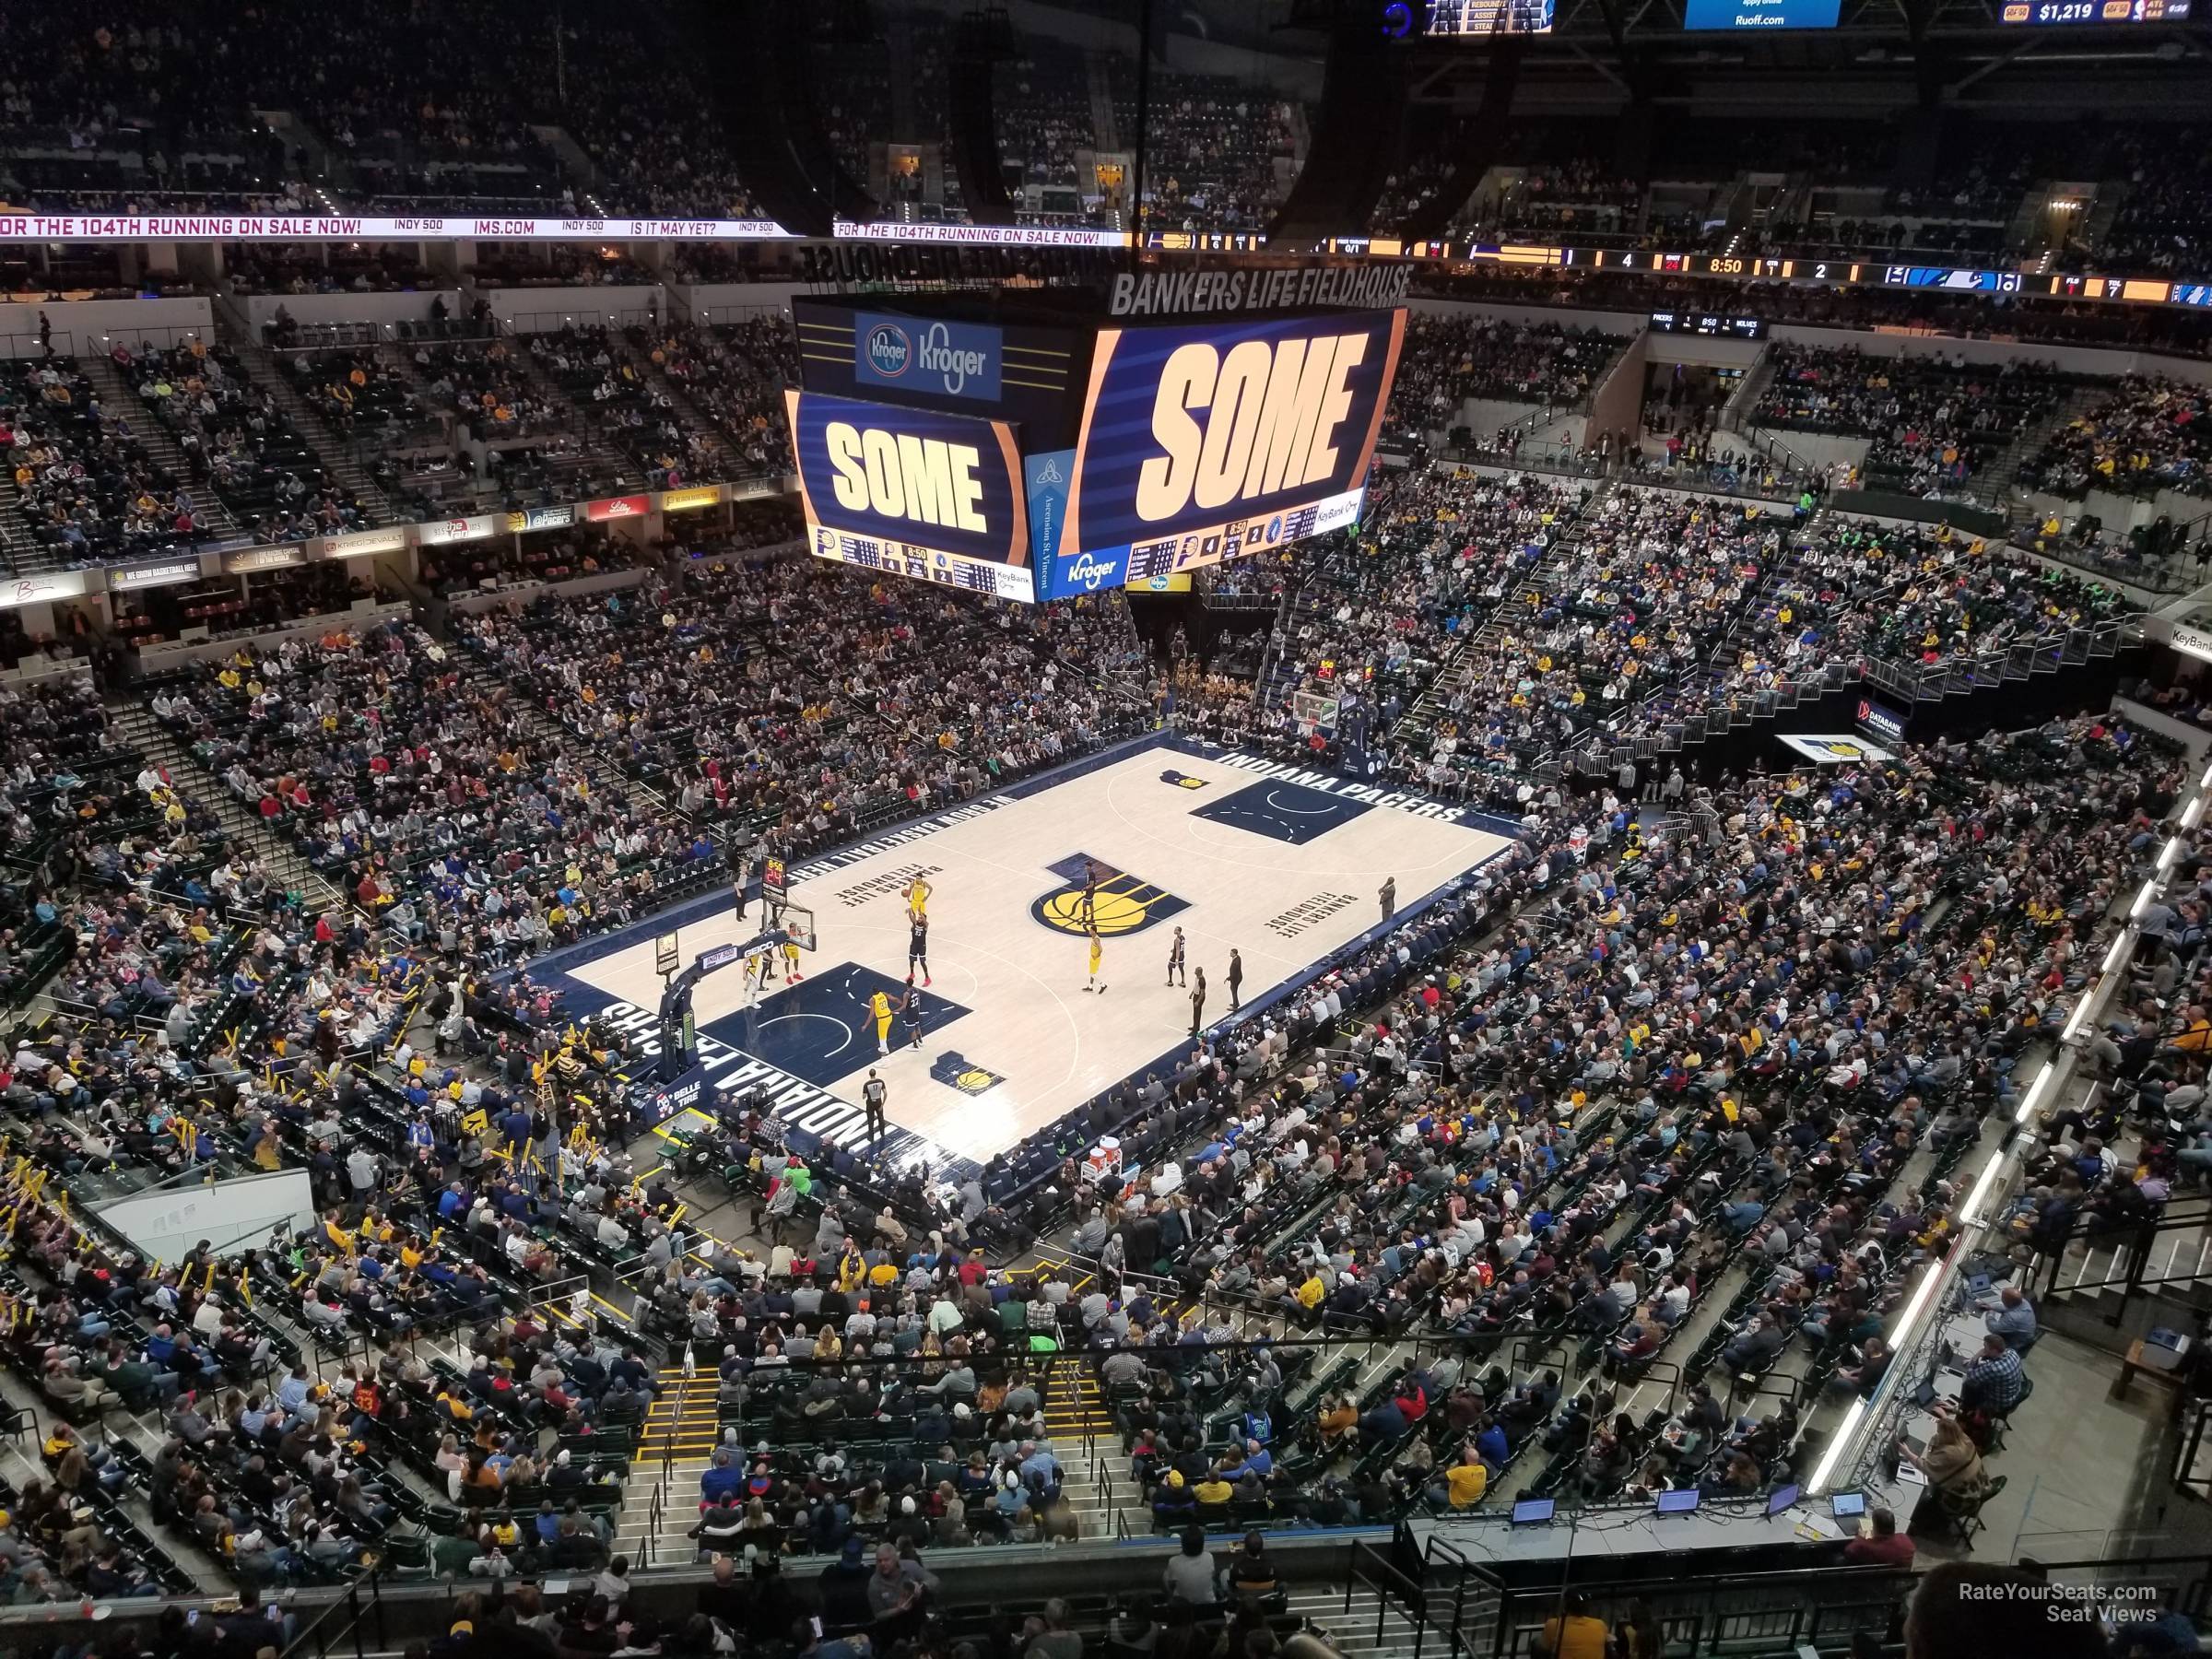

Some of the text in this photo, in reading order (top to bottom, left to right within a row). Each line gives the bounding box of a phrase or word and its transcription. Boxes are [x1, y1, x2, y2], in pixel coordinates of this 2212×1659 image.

[1735, 14, 1784, 26] Ruoff.com
[2039, 4, 2092, 21] $1,219
[34, 218, 73, 235] THE
[81, 218, 141, 235] 104TH
[147, 218, 233, 234] RUNNING
[239, 219, 263, 234] ON
[269, 219, 312, 234] SALE
[318, 219, 361, 234] NOW!
[394, 219, 442, 230] INDY 500
[474, 220, 535, 235] IMS.COM
[562, 221, 604, 231] INDY 500
[630, 222, 716, 235] IS IT MAY YET?
[739, 222, 773, 232] INDY 500
[838, 225, 1100, 244] FOR THE 104TH RUNNING ON SALE NOW!
[1238, 241, 1242, 250] 1
[1345, 244, 1359, 253] 0/1
[1622, 253, 1632, 266] 4
[1710, 258, 1742, 273] 8:50
[1770, 266, 1773, 276] 1
[1815, 265, 1826, 278] 2
[1111, 264, 1415, 315] BANKERS LIFE FIELDHOUSE
[2109, 287, 2118, 297] 7
[1653, 313, 1673, 322] PACERS
[1701, 318, 1717, 326] 8:50
[1736, 320, 1758, 328] WOLVES
[872, 331, 906, 369] Kroger
[919, 323, 986, 394] Kroger
[1135, 333, 1370, 522] SOME
[826, 421, 988, 534] SOME
[608, 500, 631, 514] Lilly
[1318, 505, 1345, 523] KeyBank
[533, 513, 571, 528] @Pacers
[1043, 495, 1054, 541] Ascension
[446, 521, 464, 532] the
[1230, 521, 1246, 535] 8:50
[1251, 528, 1259, 542] 2
[337, 540, 362, 550] KRIEG
[1206, 538, 1214, 553] 4
[907, 547, 926, 559] 8:50
[126, 562, 197, 580] WE GROW BASKETBALL HERE
[888, 559, 895, 570] 4
[1067, 553, 1117, 590] Kroger
[939, 571, 947, 582] 2
[997, 571, 1030, 584] KeyBank
[1041, 556, 1051, 590] Vincent
[1318, 668, 1332, 678] 24
[1869, 711, 1901, 734] DATABANK
[1215, 751, 1466, 823] INDIANA PACERS
[982, 794, 1015, 807] WE
[935, 803, 993, 827] GROW
[830, 816, 946, 865] BASKETBALL
[768, 859, 783, 872] 8:50
[767, 867, 782, 886] 24
[833, 863, 924, 900] FIELDHOUSE
[841, 891, 878, 908] LIFE
[1263, 891, 1337, 930] FIELDHOUSE
[1276, 894, 1359, 938] BANKERS LIFE
[707, 949, 735, 964] INDY 500
[744, 940, 774, 958] GEICO
[674, 1080, 701, 1100] BELLE
[677, 1090, 699, 1107] TIRE
[1254, 1423, 1268, 1439] 21
